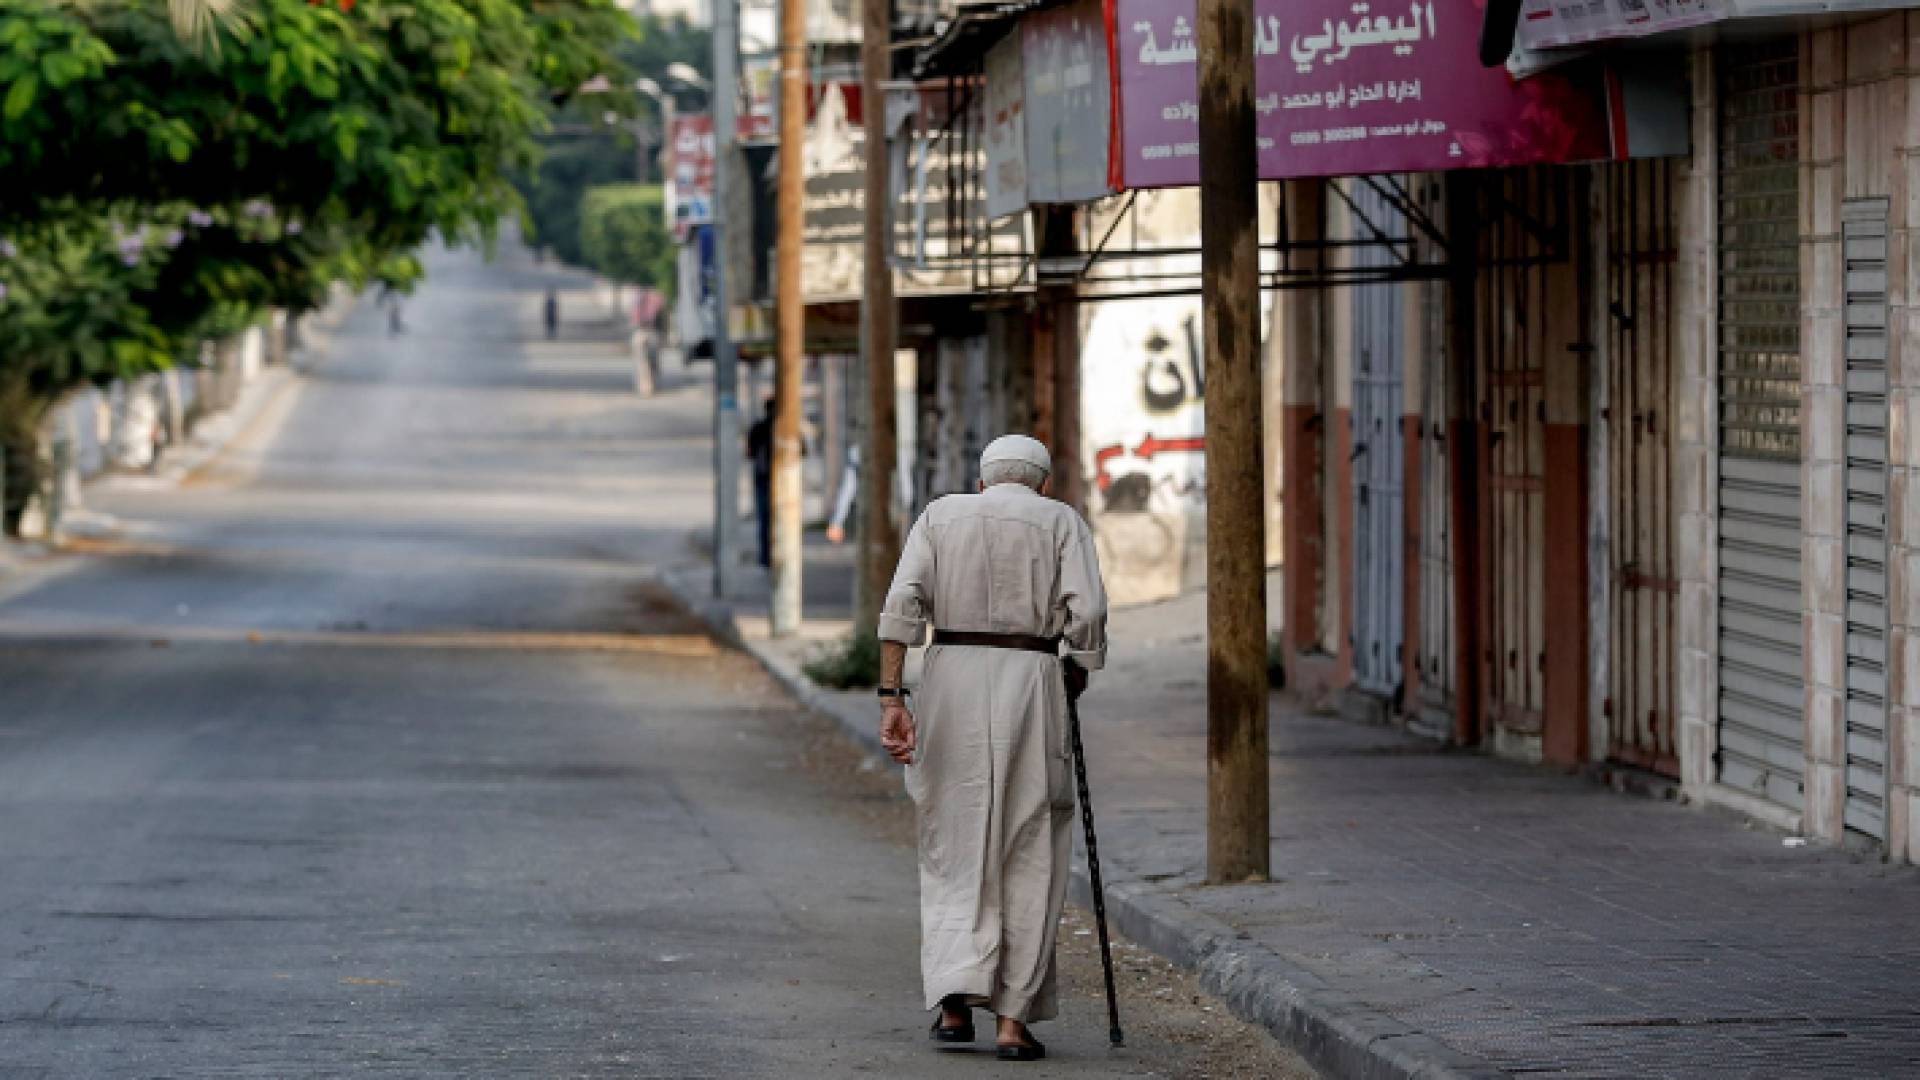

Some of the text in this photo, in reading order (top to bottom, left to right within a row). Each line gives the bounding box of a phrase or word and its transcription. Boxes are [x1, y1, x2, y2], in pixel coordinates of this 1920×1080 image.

[1291, 1, 1436, 73] اليعقوبي
[1283, 91, 1322, 109] محمد
[1325, 81, 1345, 110] أبو
[1349, 82, 1384, 108] الحاج
